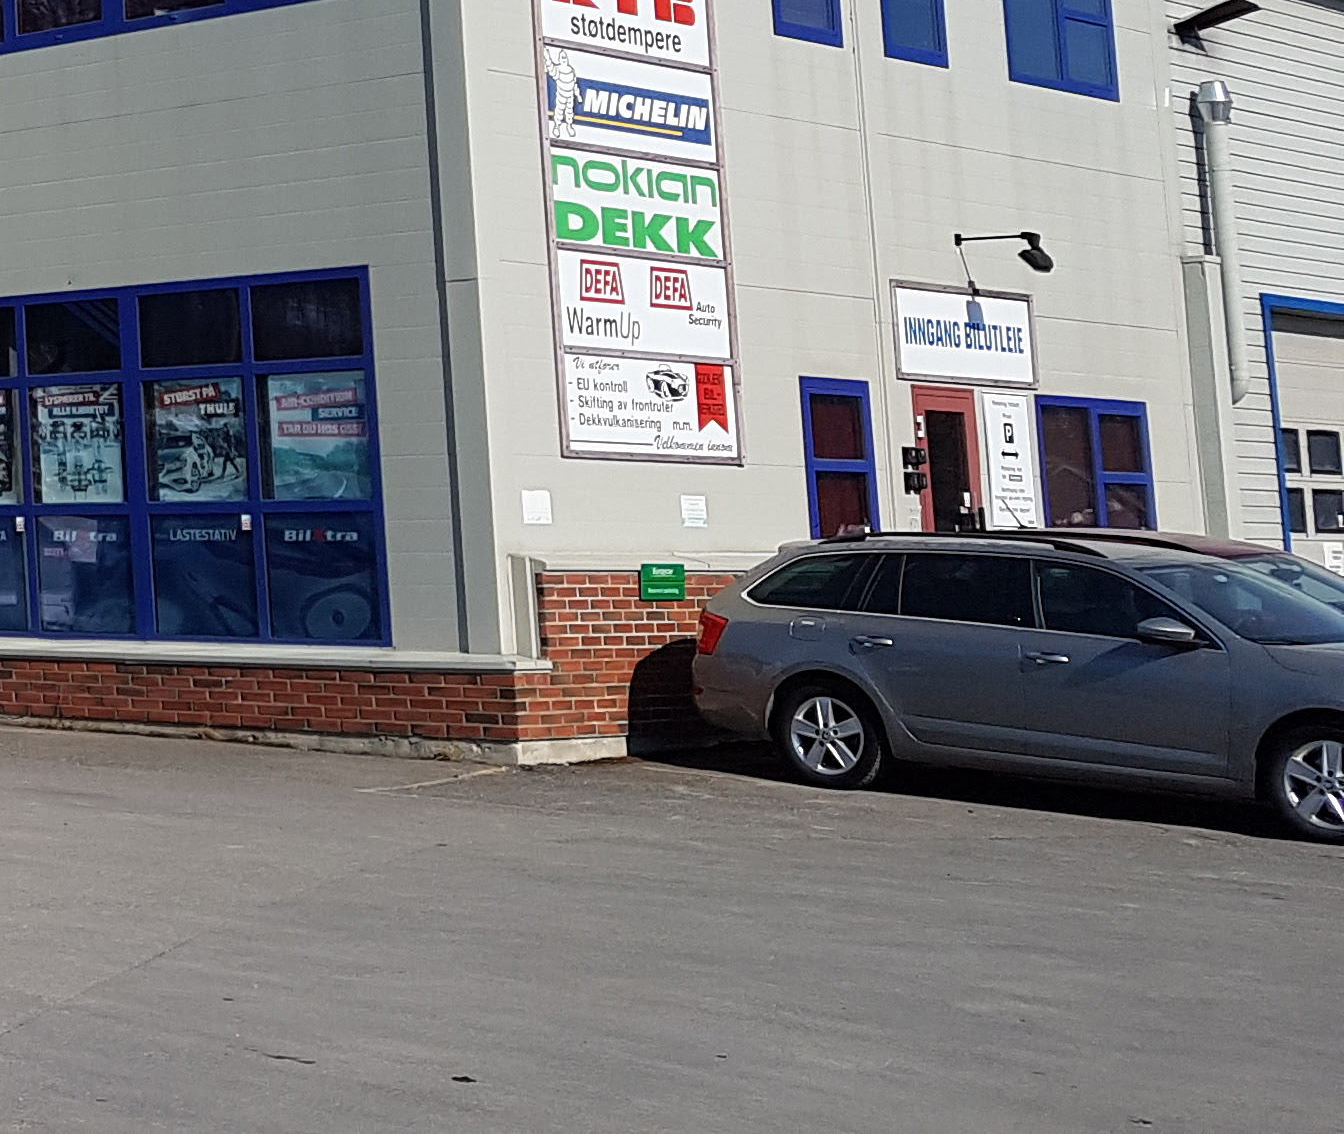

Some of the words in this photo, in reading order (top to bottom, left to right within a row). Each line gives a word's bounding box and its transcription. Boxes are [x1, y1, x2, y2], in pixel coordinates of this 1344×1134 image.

[570, 12, 682, 54] støtdempere
[583, 89, 708, 131] MICHELIN
[556, 200, 719, 258] DEKK
[584, 267, 619, 296] DEFA
[654, 274, 688, 302] DEFA
[688, 314, 722, 330] Security
[695, 302, 716, 313] Auto
[567, 306, 641, 346] WarmUp
[904, 316, 961, 348] INNGANG
[964, 322, 1025, 354] BILUTLEIE
[577, 377, 589, 390] EU
[593, 379, 628, 393] kontroll
[578, 395, 614, 412] Skifting
[617, 400, 628, 409] av
